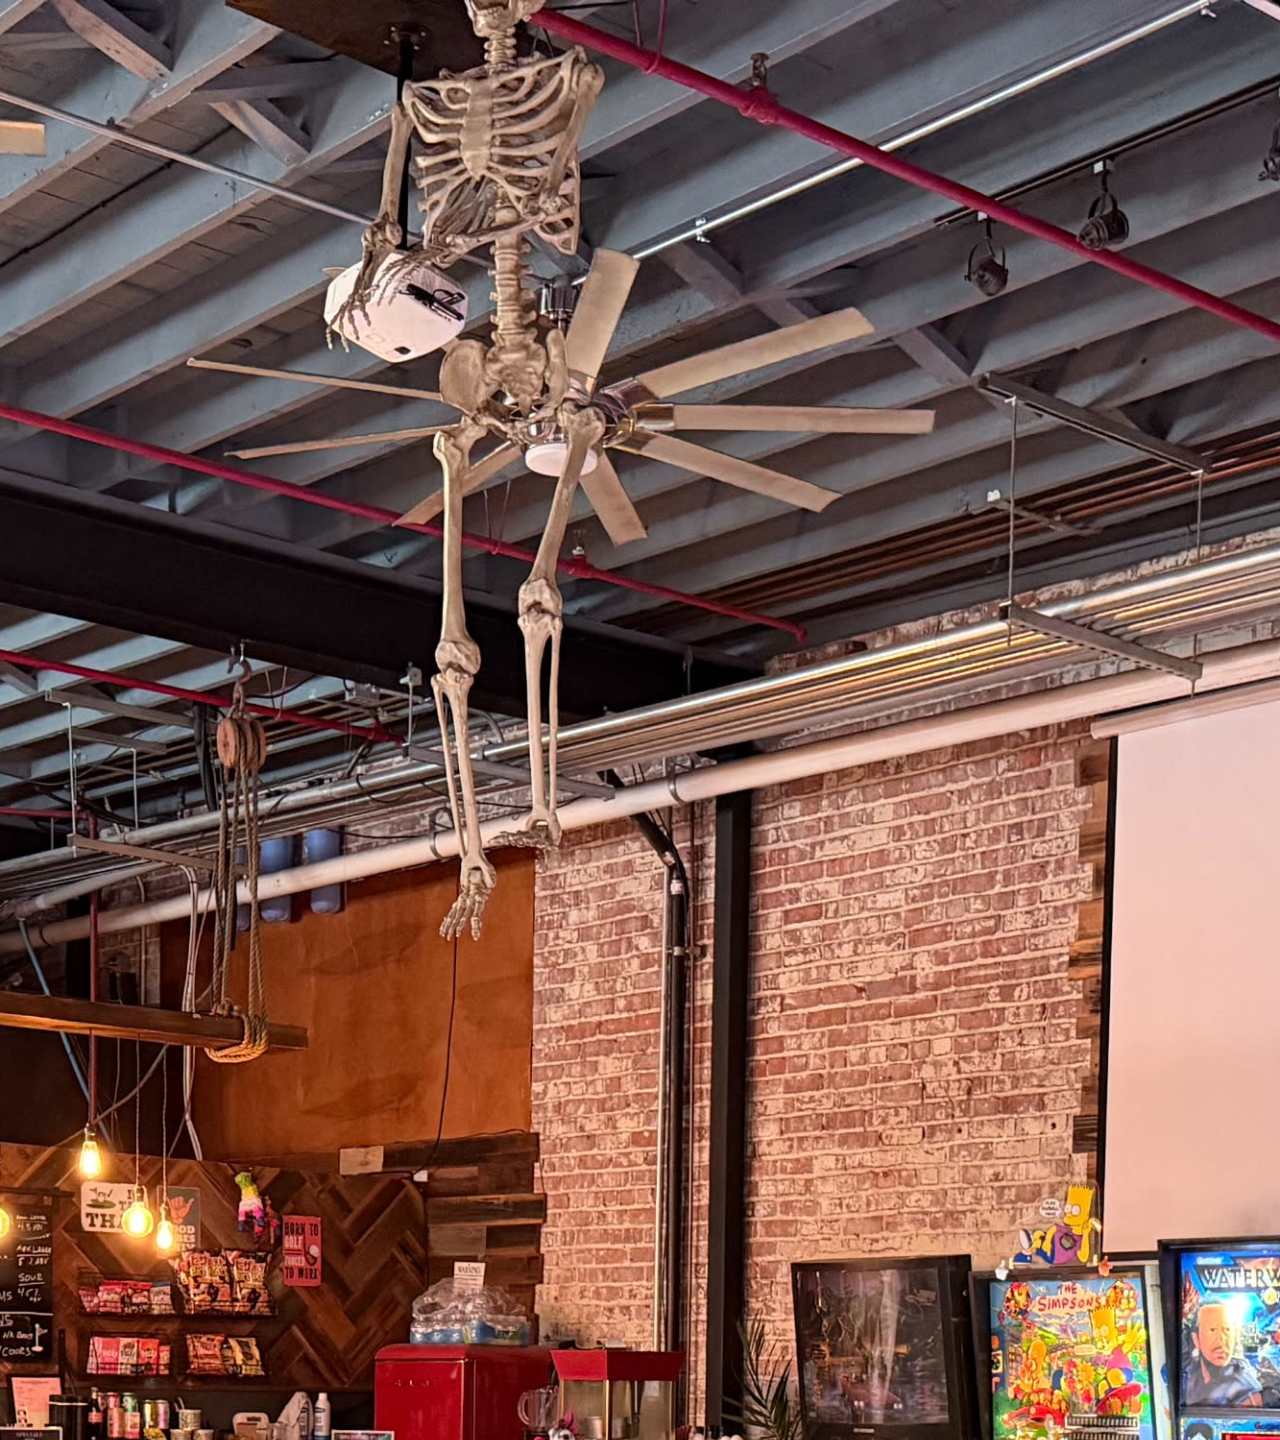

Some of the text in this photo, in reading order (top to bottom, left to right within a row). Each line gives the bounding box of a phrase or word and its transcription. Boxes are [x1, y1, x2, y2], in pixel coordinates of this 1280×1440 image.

[309, 1223, 318, 1236] TO
[1057, 1282, 1078, 1296] THE
[1037, 1295, 1103, 1312] SIMPSONS
